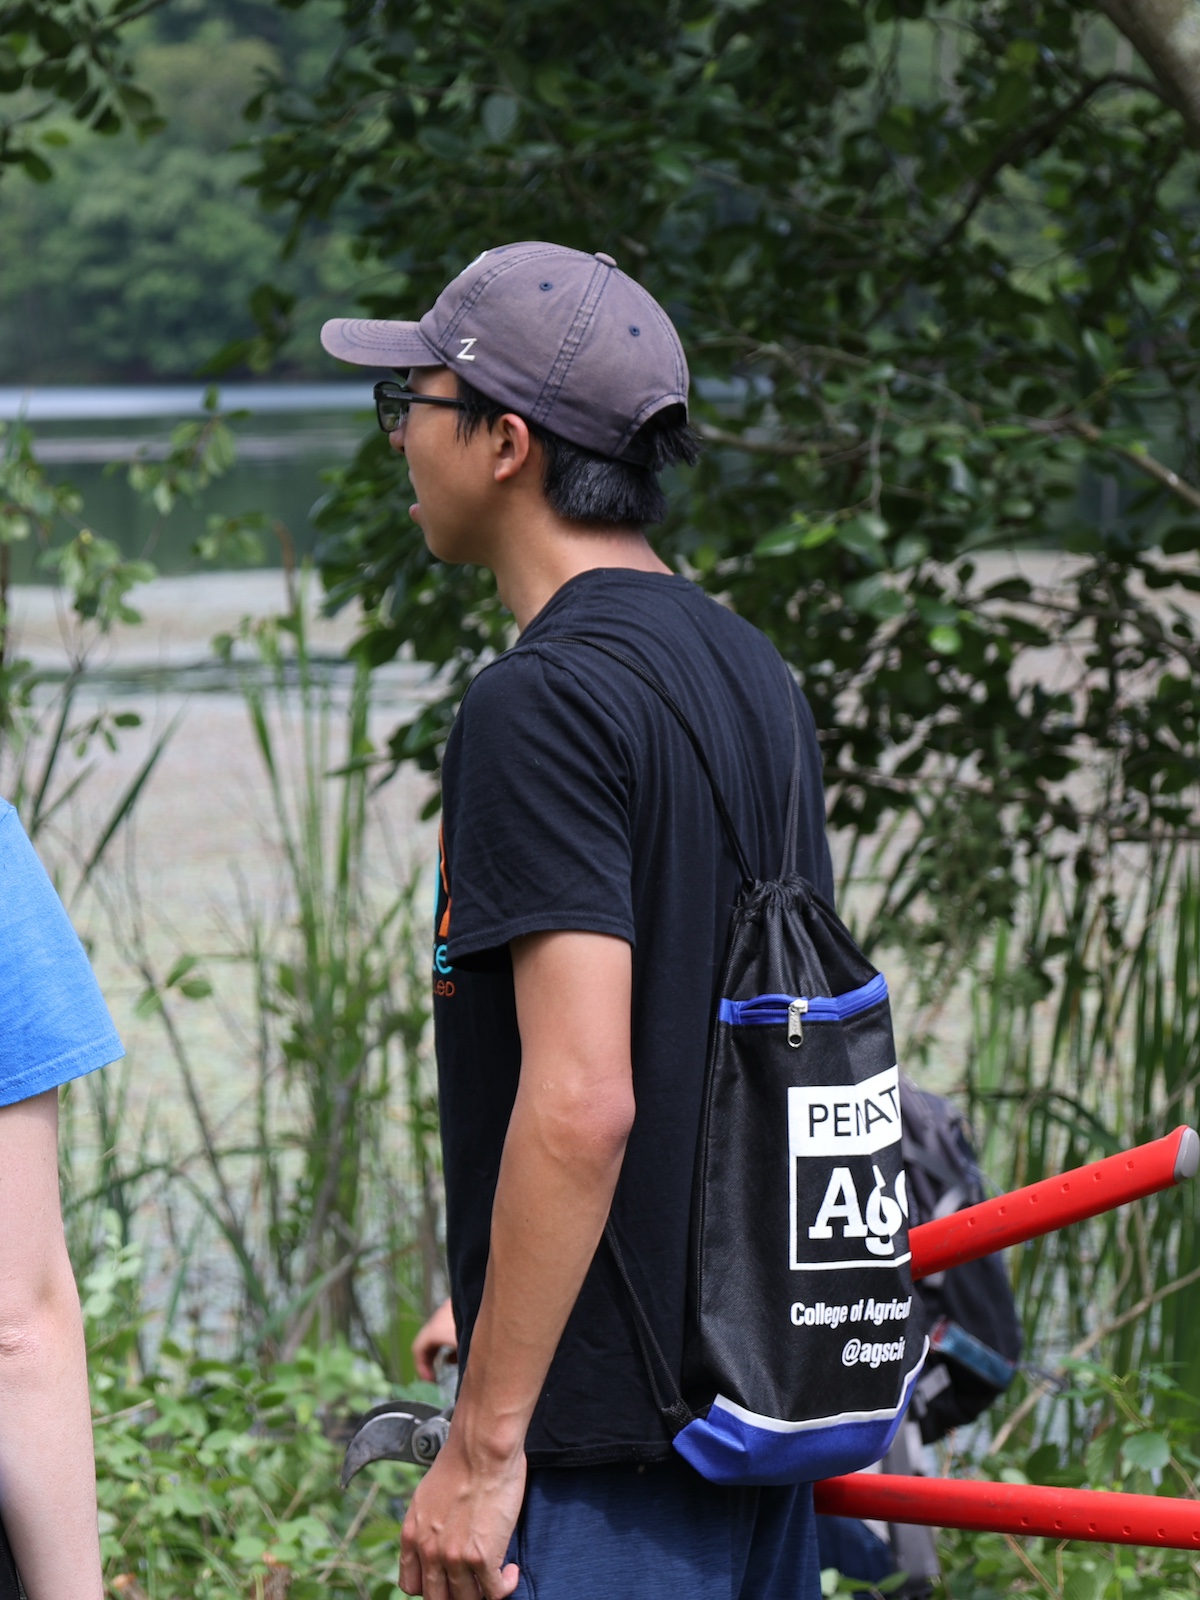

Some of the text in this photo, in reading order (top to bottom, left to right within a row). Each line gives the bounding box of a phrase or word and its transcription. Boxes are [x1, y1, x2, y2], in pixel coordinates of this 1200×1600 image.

[456, 337, 478, 361] Z
[790, 1301, 849, 1329] College
[849, 1298, 865, 1323] of
